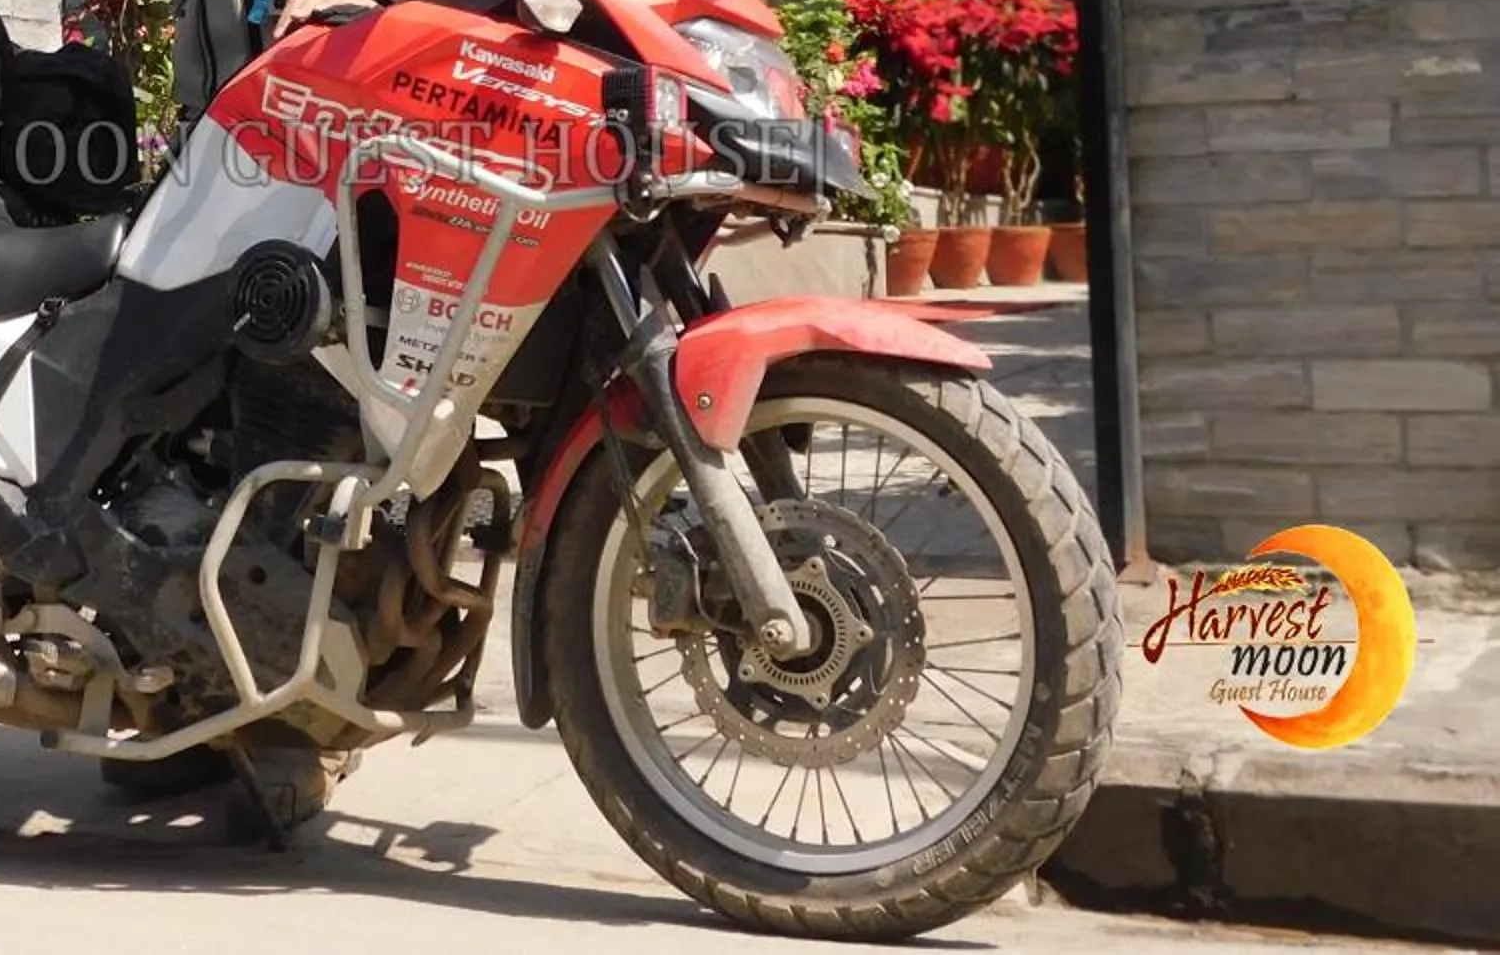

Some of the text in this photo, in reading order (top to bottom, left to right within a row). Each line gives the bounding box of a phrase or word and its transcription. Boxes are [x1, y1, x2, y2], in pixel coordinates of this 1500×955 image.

[460, 41, 556, 84] Kawasaki
[402, 175, 501, 217] Syntheti
[517, 208, 551, 231] Oil
[396, 353, 477, 387] SHD
